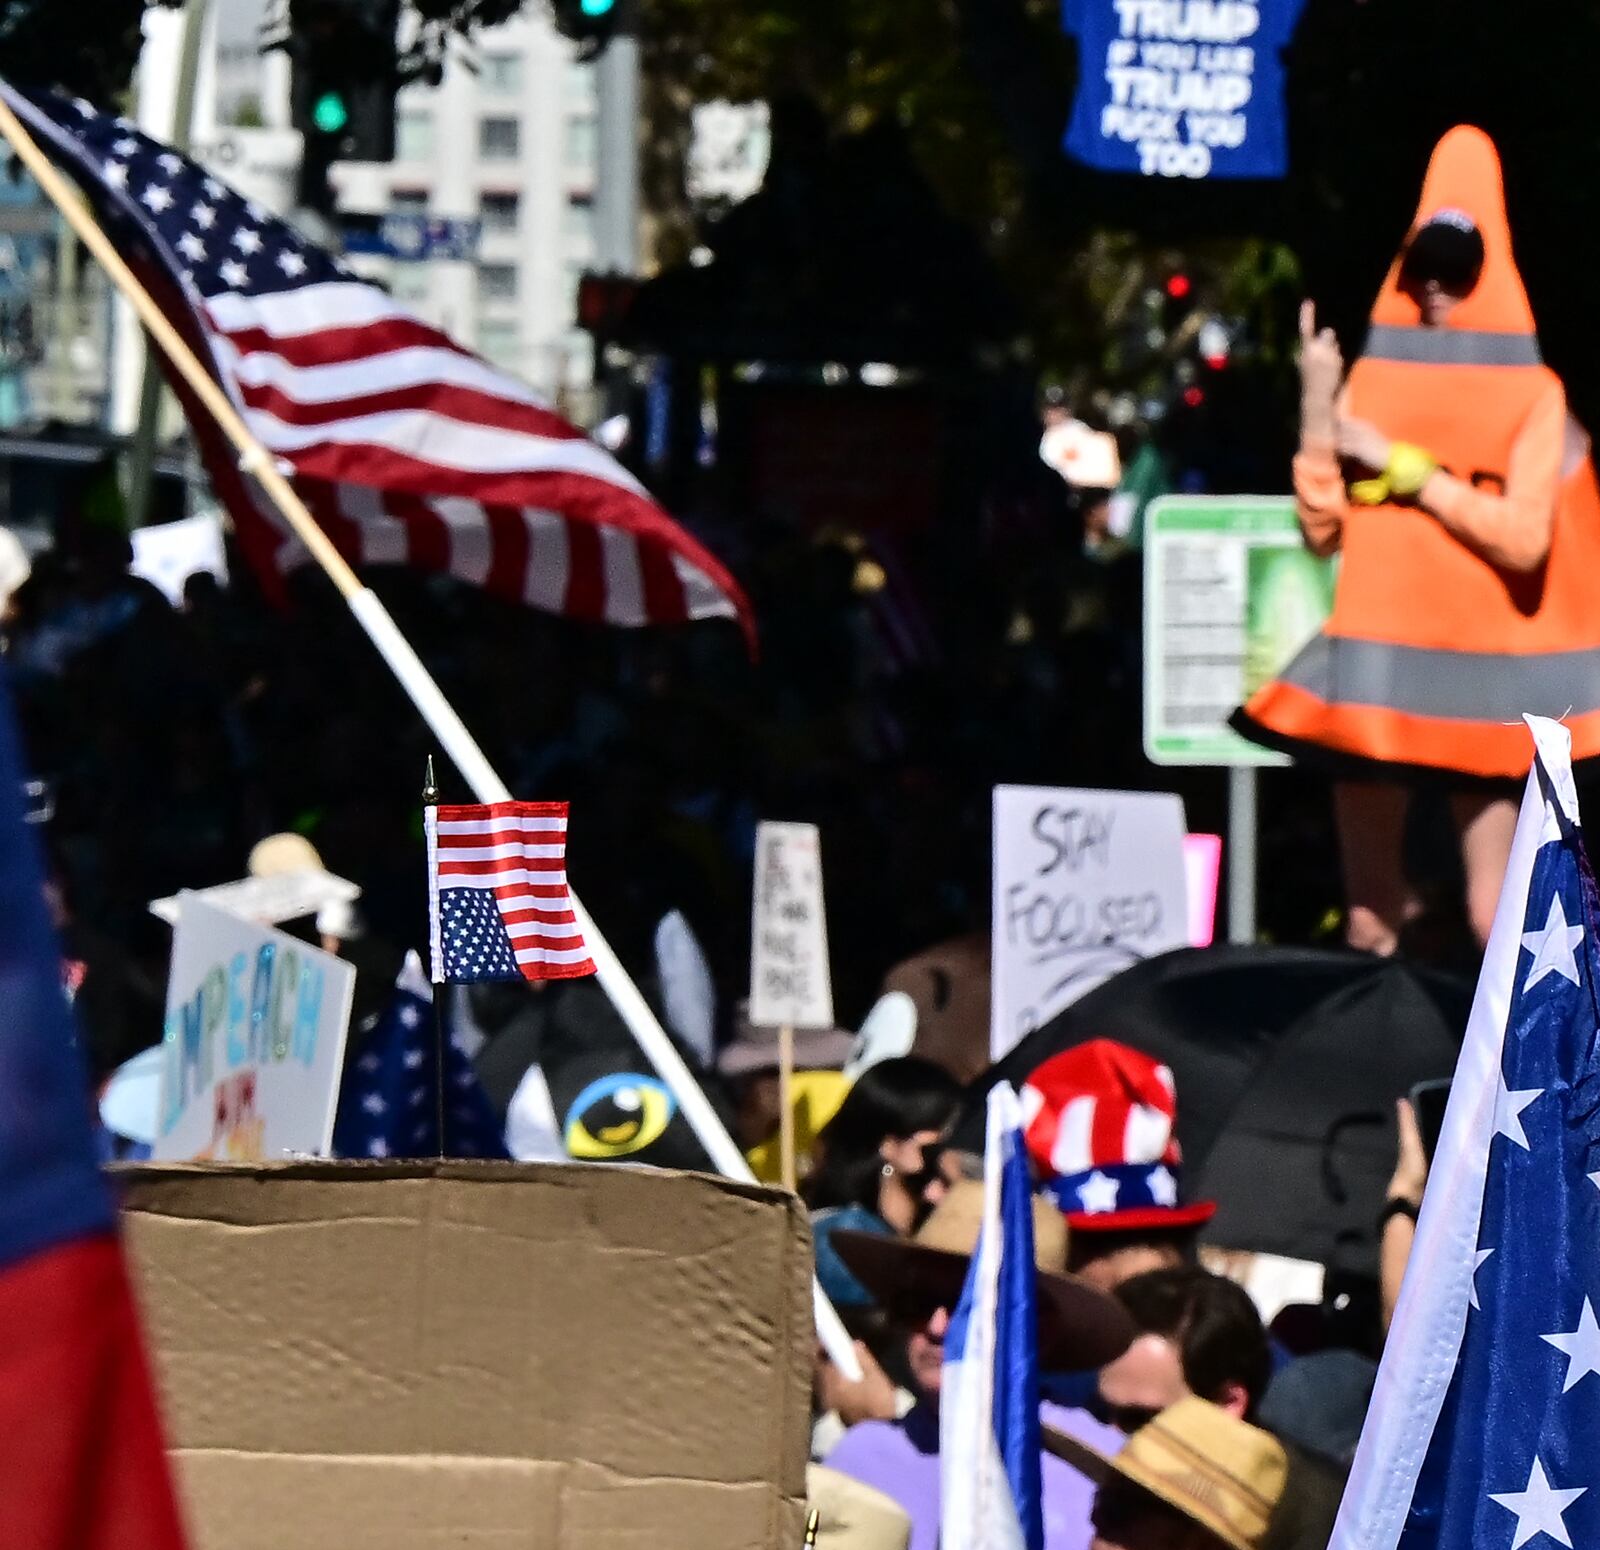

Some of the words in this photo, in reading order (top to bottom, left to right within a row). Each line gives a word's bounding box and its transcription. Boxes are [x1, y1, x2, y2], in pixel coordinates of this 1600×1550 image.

[1105, 67, 1252, 114] TRUMP
[1101, 104, 1178, 142] FUCK
[1185, 113, 1246, 148] YOU
[1136, 141, 1211, 178] TOO
[1031, 802, 1116, 877] STAY
[163, 943, 324, 1138] IMPEACH
